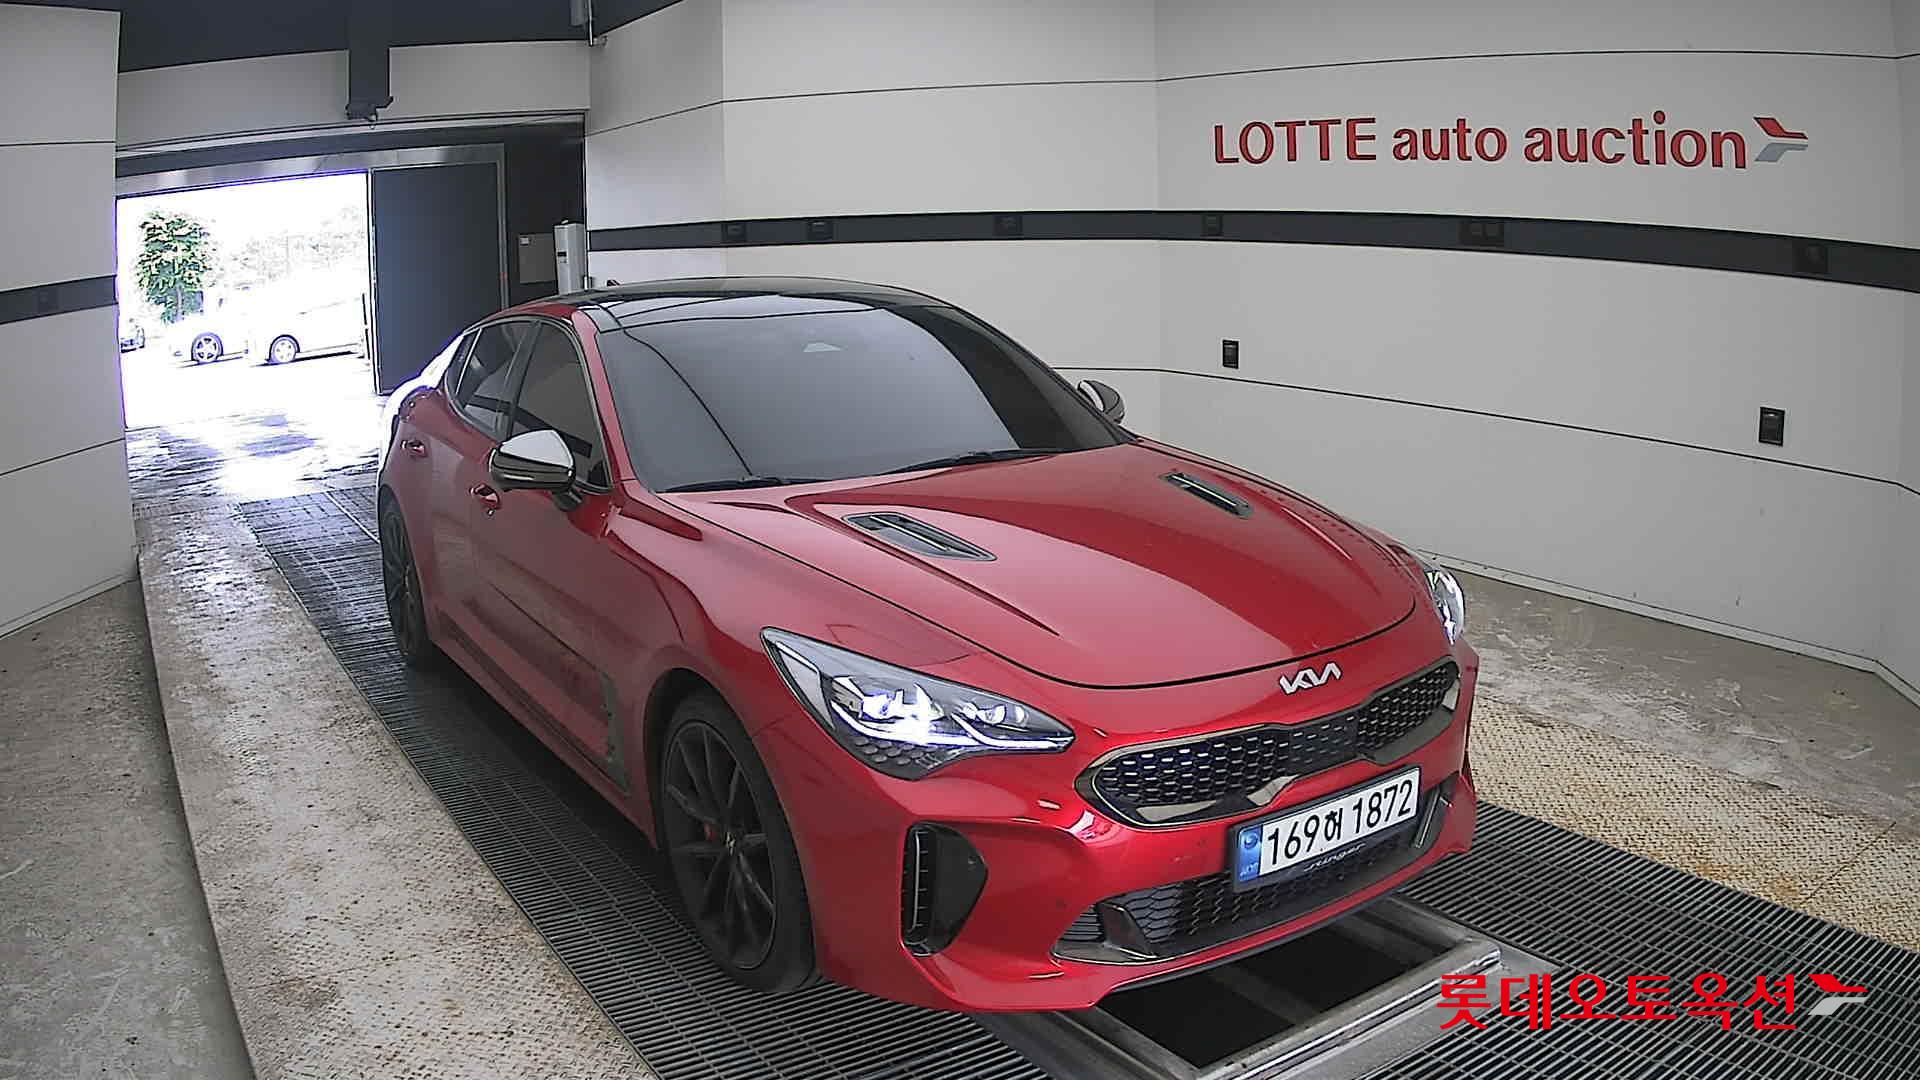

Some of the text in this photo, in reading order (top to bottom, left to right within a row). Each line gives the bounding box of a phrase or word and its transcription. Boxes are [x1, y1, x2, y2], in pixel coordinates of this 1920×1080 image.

[1214, 110, 1748, 169] LOTTE auto auction
[1267, 779, 1413, 866] 169허 1872
